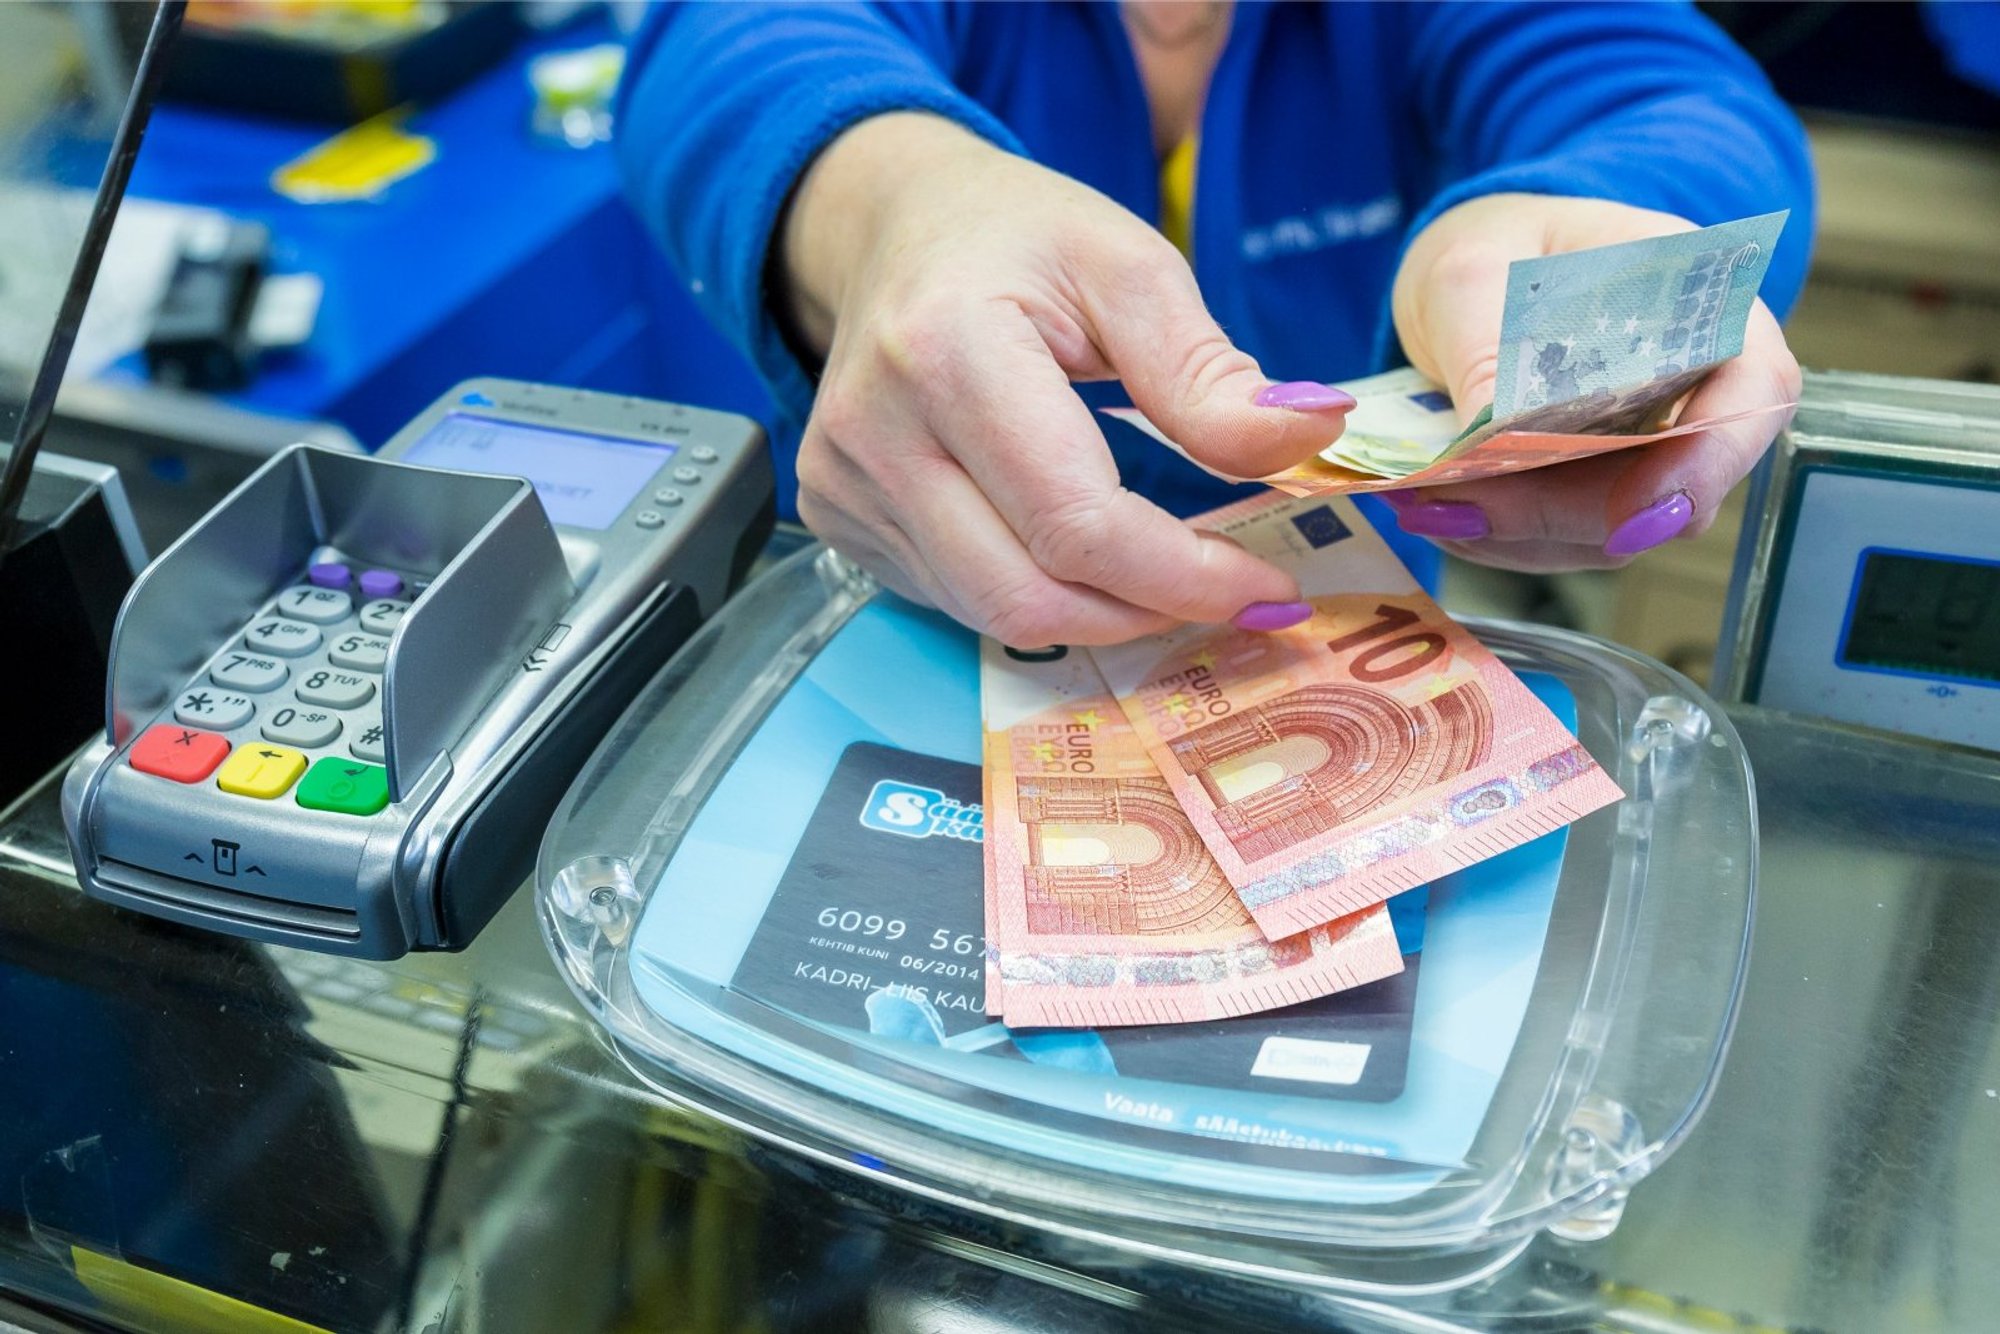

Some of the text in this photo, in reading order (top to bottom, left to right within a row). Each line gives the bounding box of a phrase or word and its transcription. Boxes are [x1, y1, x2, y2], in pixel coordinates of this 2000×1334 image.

[294, 590, 312, 605] 1
[370, 603, 394, 620] 2
[256, 622, 308, 638] 4 GHI
[339, 636, 365, 653] 5
[1326, 604, 1447, 683] 10
[222, 654, 276, 672] 7 PRS
[305, 671, 363, 689] 8 TUV
[1183, 664, 1231, 717] EURO
[272, 708, 296, 727] 0
[1065, 723, 1095, 774] EURO
[817, 907, 907, 940] 6099
[808, 936, 979, 981] KEHTIB KUNI 06/2014
[1103, 1091, 1174, 1124] Vaata
